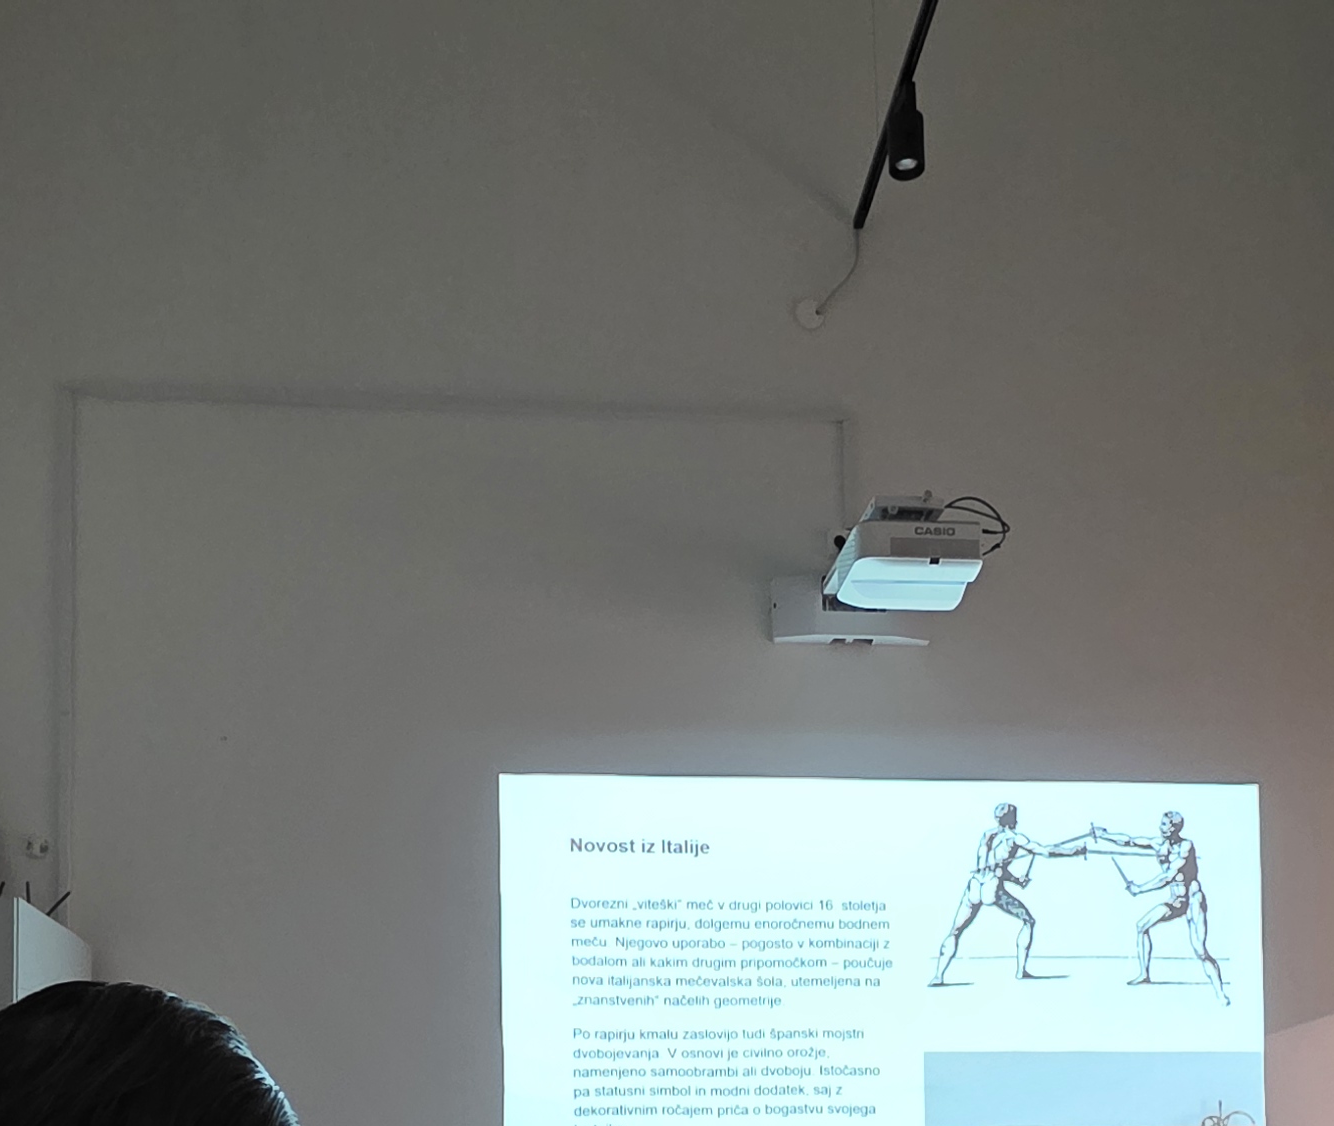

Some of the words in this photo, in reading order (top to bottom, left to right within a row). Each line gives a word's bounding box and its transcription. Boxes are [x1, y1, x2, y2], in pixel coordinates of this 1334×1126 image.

[914, 526, 956, 537] CASIO
[570, 838, 635, 853] Novost
[642, 838, 655, 854] iz
[662, 839, 710, 858] Italije
[571, 897, 628, 909] Dvorezni
[687, 899, 713, 910] meč
[718, 902, 725, 910] v
[729, 900, 761, 913] drugi
[766, 900, 813, 913] polovici
[841, 900, 886, 914] stoletja
[571, 919, 586, 928] se
[590, 917, 642, 929] umakne
[695, 918, 750, 932] dolgemu
[754, 918, 834, 930] enoročnemu
[839, 919, 890, 930] bodnem
[616, 937, 668, 951] Njegovo
[672, 938, 725, 951] uporabo
[742, 939, 793, 952] pogosto
[797, 941, 804, 949] v
[809, 938, 879, 952] kombinaciji
[883, 940, 890, 949] z
[572, 955, 627, 967] bodalom
[632, 956, 646, 967] ali
[650, 957, 688, 968] kakim
[692, 957, 736, 971] drugim
[741, 957, 827, 971] pripomočkom
[843, 957, 893, 971] poučuje
[572, 976, 604, 985] nova
[608, 975, 671, 989] italijanska
[676, 975, 752, 987] mečevalska
[757, 976, 786, 988] šola,
[791, 976, 861, 989] utemeljena
[865, 978, 880, 987] na
[664, 995, 709, 1006] načelih
[573, 1028, 590, 1040] Po
[594, 1029, 635, 1043] rapirju
[640, 1029, 678, 1040] kmalu
[682, 1029, 738, 1042] zaslovijo
[742, 1029, 765, 1040] tudi
[770, 1028, 818, 1041] španski
[823, 1029, 864, 1041] mojstri
[667, 1048, 677, 1058] V
[681, 1049, 723, 1059] osnovi
[727, 1049, 738, 1062] je
[743, 1048, 783, 1058] civilno
[573, 1067, 647, 1080] namenjeno
[650, 1066, 738, 1078] samoobrambi
[742, 1066, 757, 1077] ali
[820, 1065, 880, 1076] Istočasno
[573, 1088, 590, 1100] pa
[594, 1086, 645, 1097] statusni
[649, 1085, 691, 1096] simbol
[695, 1086, 706, 1096] in
[711, 1086, 750, 1097] modni
[813, 1085, 831, 1098] saj
[836, 1086, 842, 1095] z
[574, 1105, 658, 1117] dekorativnim
[662, 1104, 713, 1119] ročajem
[718, 1104, 749, 1118] priča
[753, 1106, 761, 1115] o
[765, 1104, 823, 1117] bogastvu
[827, 1104, 876, 1117] svojega
